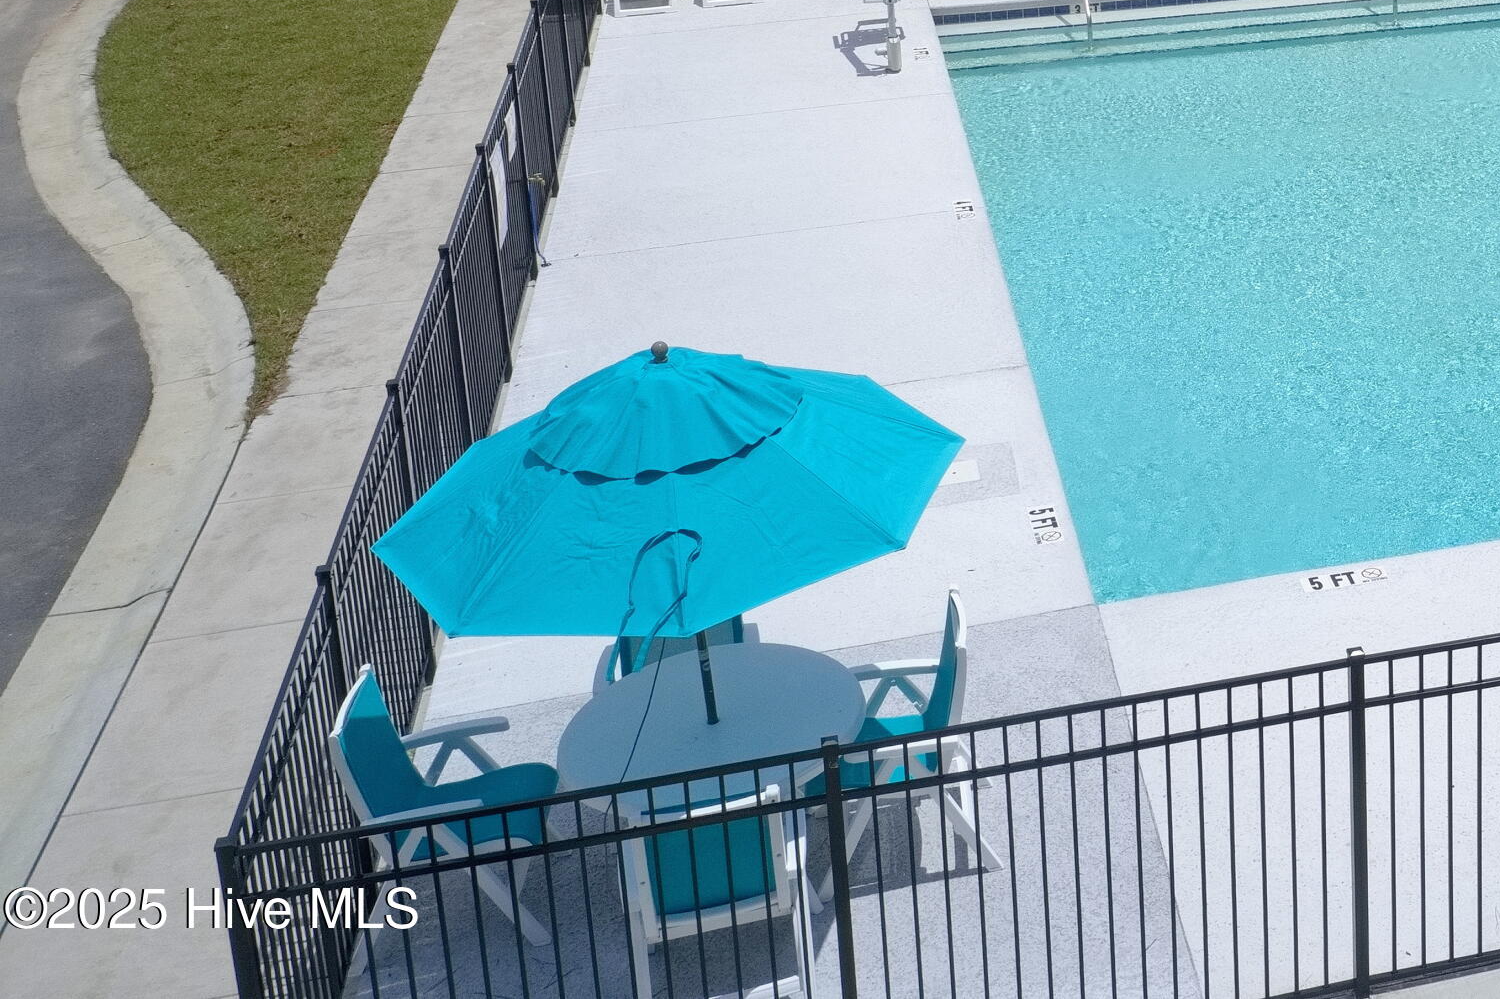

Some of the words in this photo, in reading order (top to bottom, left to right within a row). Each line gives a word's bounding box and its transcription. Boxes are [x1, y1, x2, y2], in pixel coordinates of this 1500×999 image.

[1029, 507, 1054, 515] 5
[1031, 516, 1058, 529] FT
[1308, 576, 1324, 591] 5
[1330, 571, 1355, 588] FT
